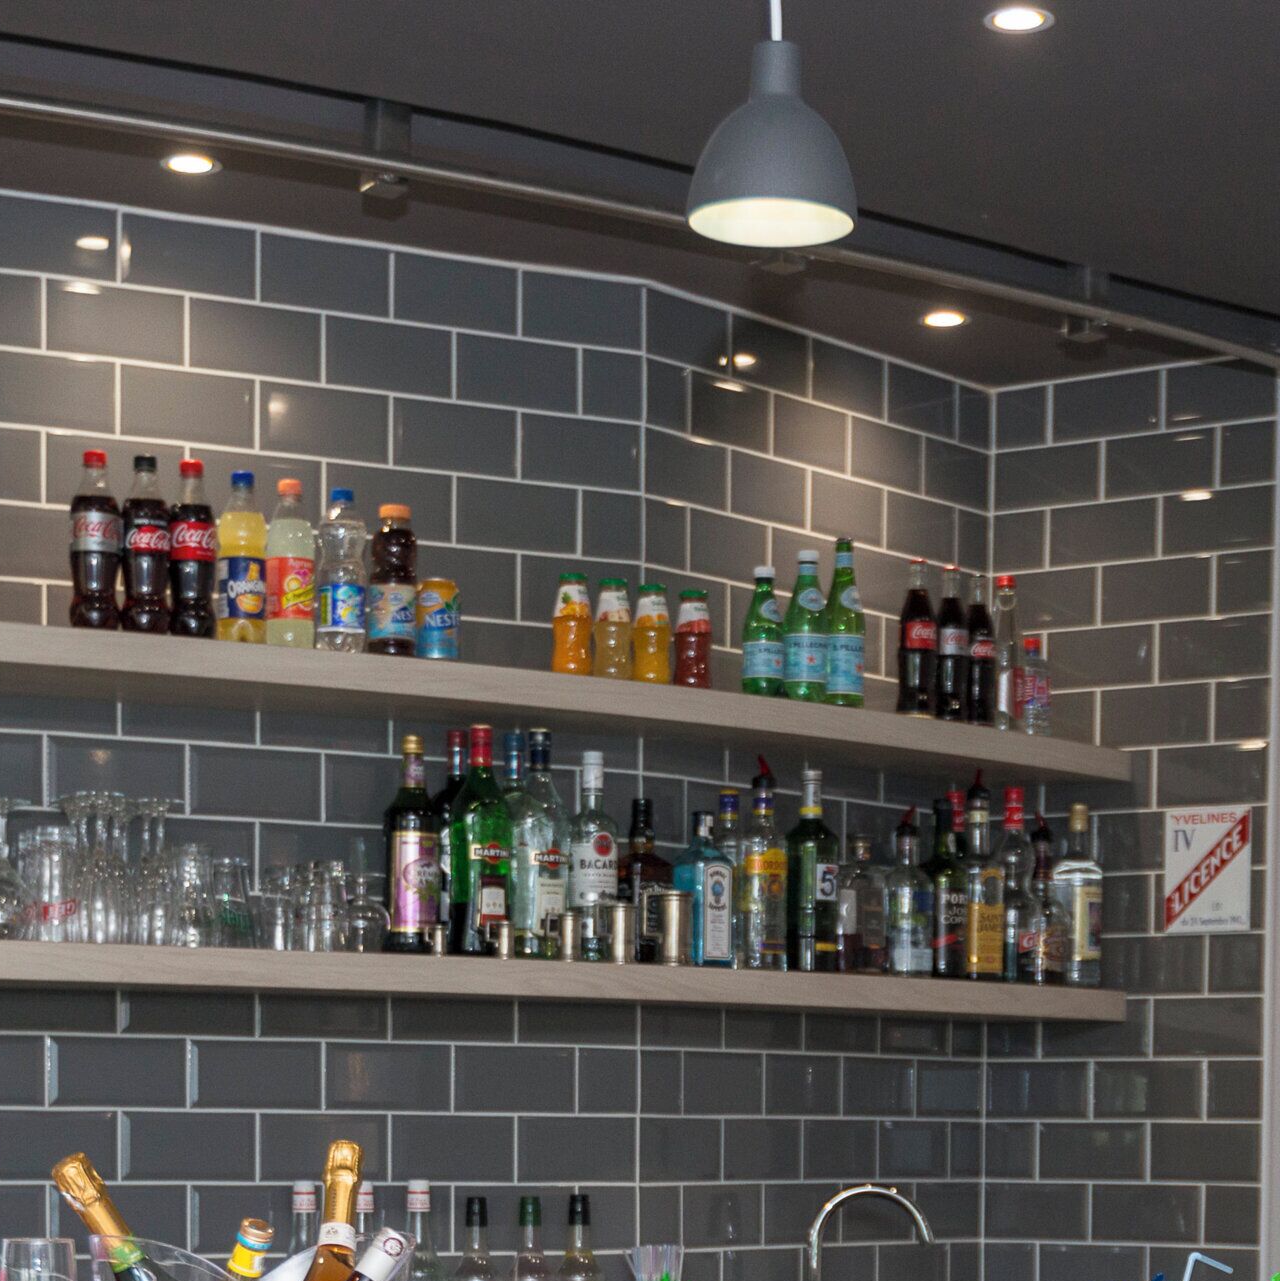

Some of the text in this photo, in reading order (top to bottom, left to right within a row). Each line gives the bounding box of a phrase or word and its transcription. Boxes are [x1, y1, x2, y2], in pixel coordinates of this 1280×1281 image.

[1171, 812, 1238, 825] YVELINES
[1173, 829, 1196, 852] IV
[1172, 824, 1242, 913] LICENCE
